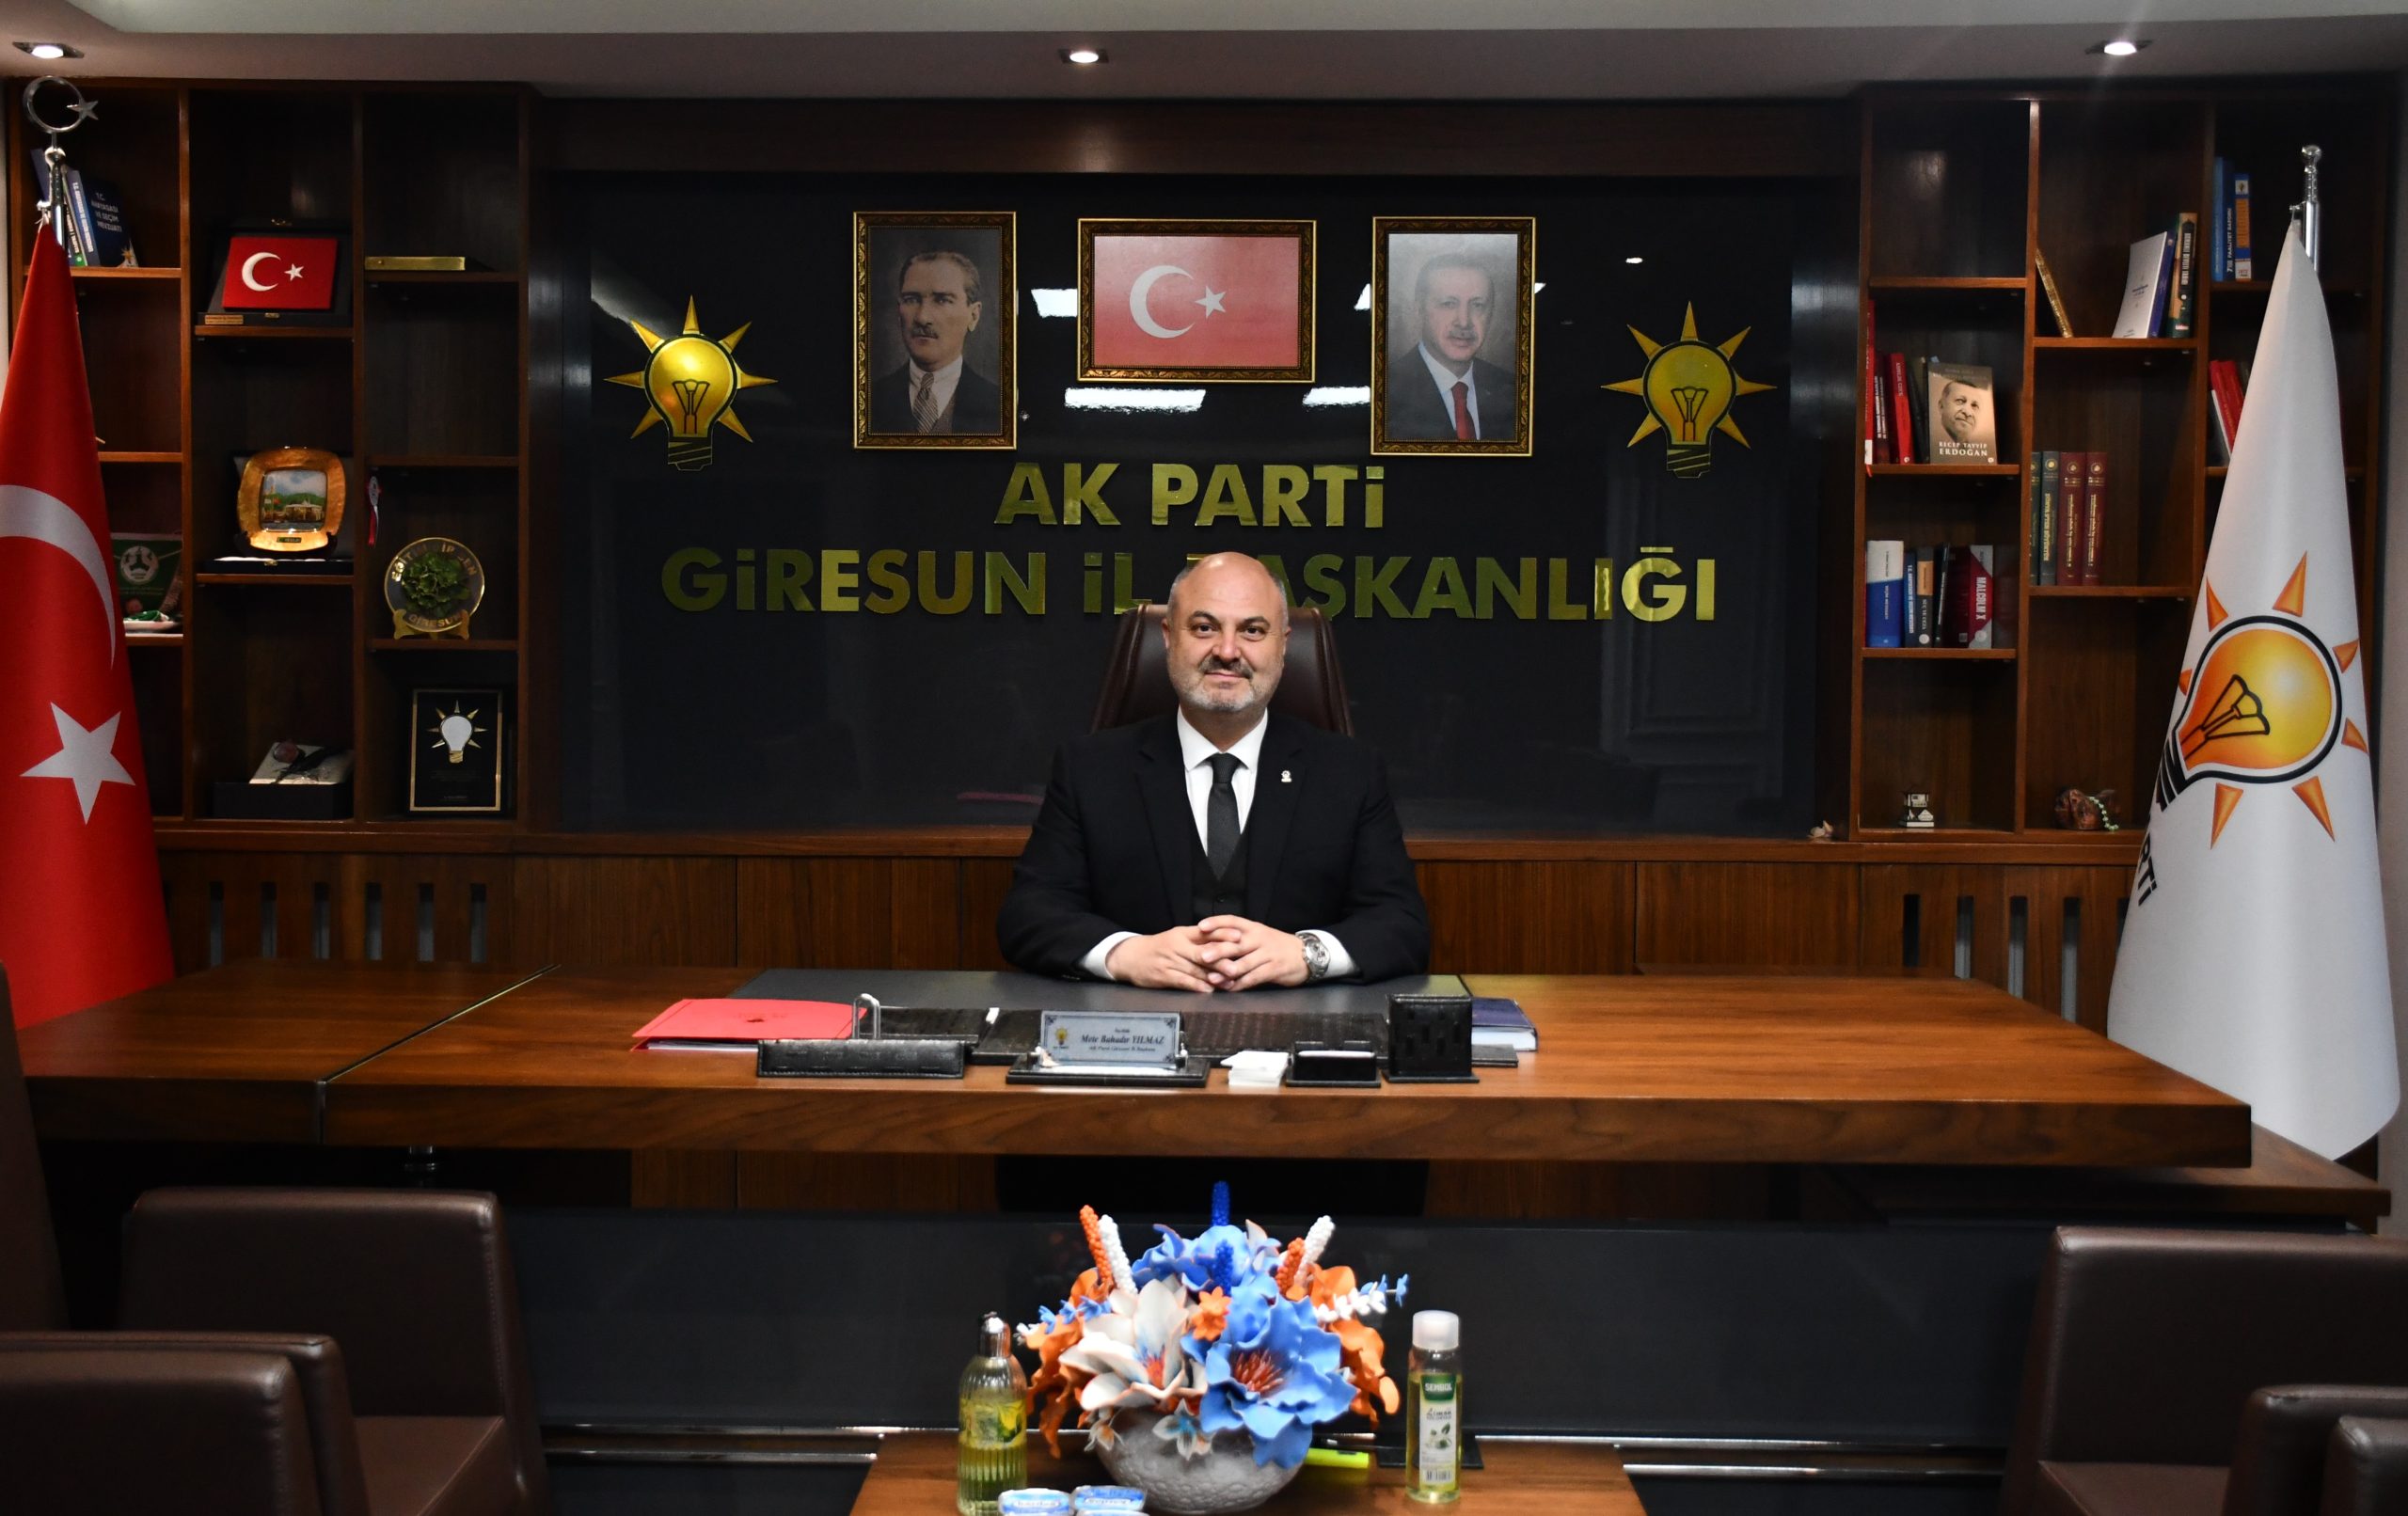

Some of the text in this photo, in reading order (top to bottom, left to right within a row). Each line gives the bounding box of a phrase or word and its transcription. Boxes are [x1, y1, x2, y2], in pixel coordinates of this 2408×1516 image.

[1939, 447, 1988, 457] ERDOĞAN
[993, 463, 1385, 529] AK PARTİ
[660, 546, 1717, 623] GİRESUN İL AŞKANLIĞI
[1975, 576, 1987, 613] MALCOLM
[1081, 1034, 1164, 1045] Mete Bahadır YILMAZ
[1424, 1382, 1453, 1392] SEMBOL
